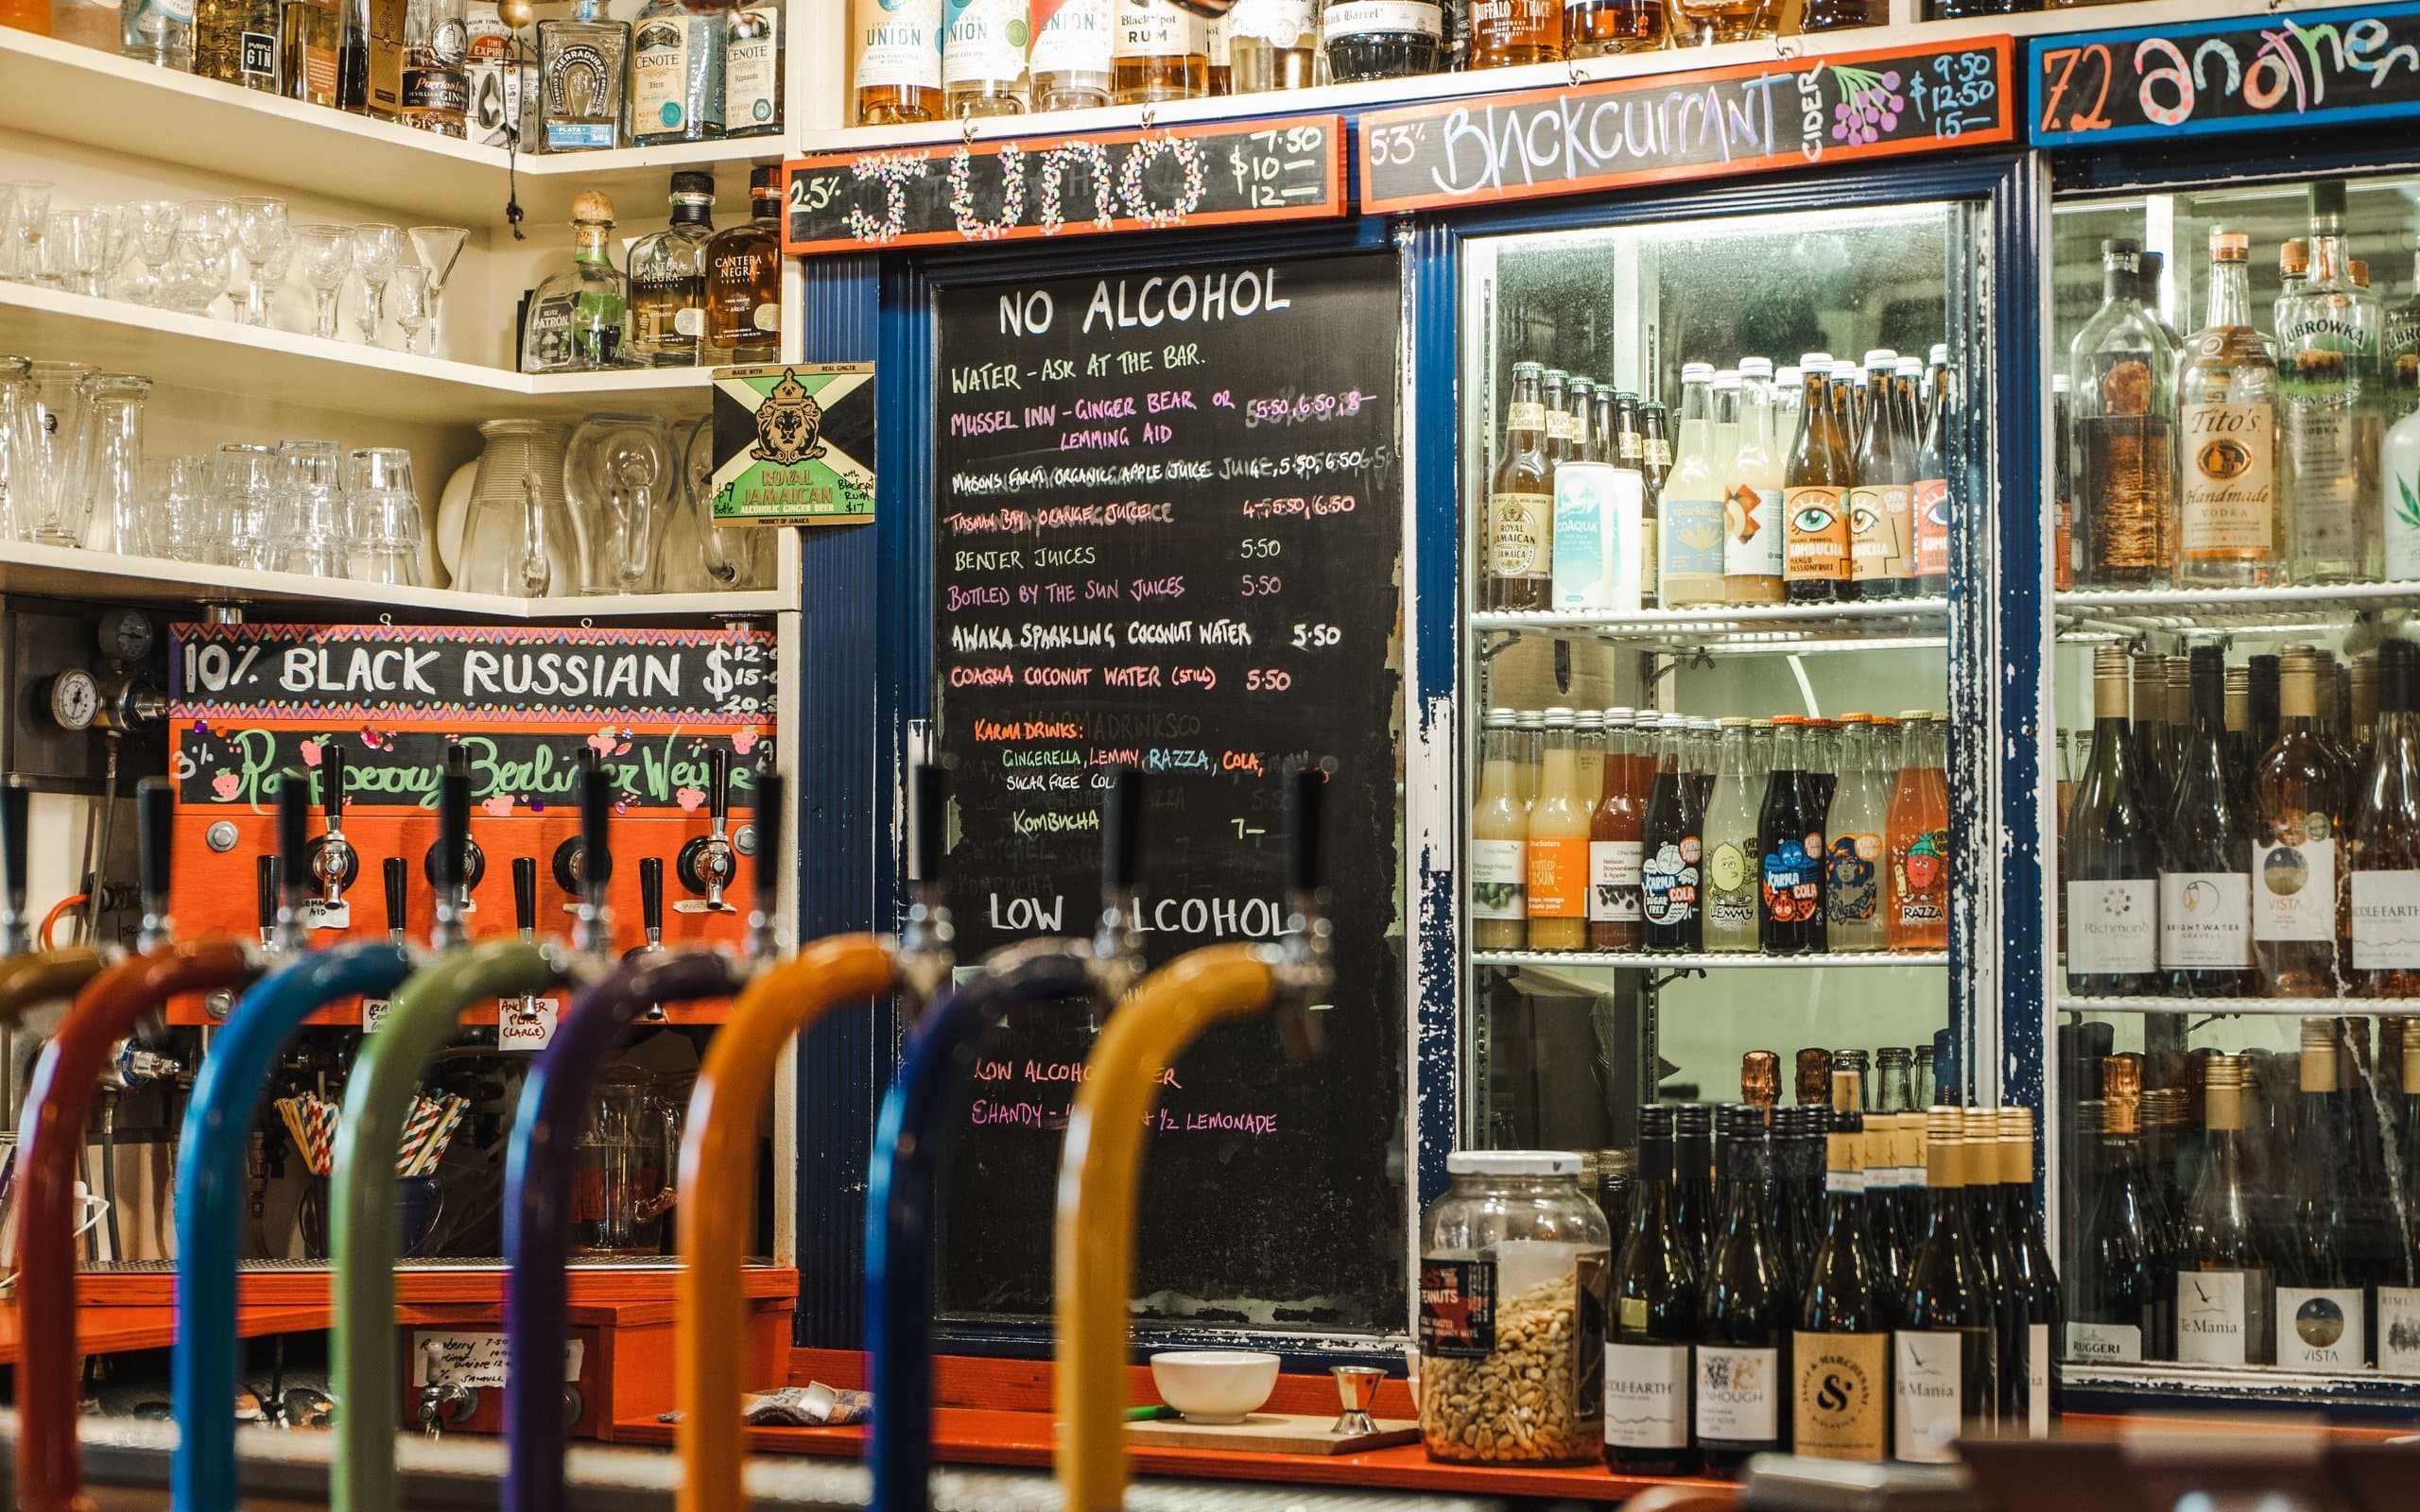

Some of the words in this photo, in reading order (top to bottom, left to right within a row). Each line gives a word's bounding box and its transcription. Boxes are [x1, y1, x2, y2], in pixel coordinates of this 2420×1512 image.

[1475, 1, 1512, 21] BUFFALO
[1120, 14, 1152, 26] Black
[486, 39, 504, 47] TIME
[866, 27, 922, 46] UNION
[1128, 29, 1168, 43] RUM
[247, 51, 271, 67] GIN
[634, 53, 681, 70] CENOTE
[727, 44, 769, 62] CENOTE
[554, 50, 606, 75] HERRADURA
[438, 91, 460, 103] GIN
[1797, 60, 1824, 163] CIDER
[636, 262, 682, 274] CANTERA
[715, 255, 763, 268] CANTERA
[643, 272, 679, 283] NEGRA
[720, 266, 757, 278] NEGRA
[998, 289, 1054, 337] NO
[1081, 267, 1291, 334] ALCOHOL
[952, 362, 1021, 394] WATER
[1042, 358, 1077, 382] ASK
[1087, 352, 1113, 378] AT
[1116, 350, 1153, 375] THE
[950, 410, 1019, 438] MUSSEL
[1024, 404, 1057, 429] INN
[1074, 396, 1137, 421] GINGER
[1147, 388, 1198, 415] BEAR
[1212, 388, 1236, 410] OR
[1060, 426, 1131, 452] LEMMING
[1142, 421, 1173, 446] AID
[762, 469, 814, 487] ROYAL
[952, 472, 1003, 495] MASONS
[1008, 465, 1045, 490] FARM
[1054, 464, 1113, 487] ORGANIC
[1121, 460, 1164, 481] APPLE
[1165, 459, 1214, 480] JUICE
[741, 486, 834, 506] JAMAICAN
[2185, 484, 2270, 506] Handmade
[739, 505, 780, 514] ALCOHOLIC
[783, 504, 811, 513] GINGER
[814, 503, 835, 512] BEER
[844, 503, 865, 514] $17
[2202, 508, 2249, 518] VODKA
[949, 511, 994, 532] TASMAN
[1038, 506, 1094, 527] ORANGE
[1499, 524, 1525, 533] ROYAL
[1494, 533, 1536, 545] JAMAICAN
[955, 549, 1024, 573] BENJER
[1035, 546, 1097, 568] JUICES
[1240, 539, 1282, 558] 5.50
[1498, 549, 1527, 558] JAMAICA
[1789, 542, 1844, 558] KOMBUCHA
[946, 584, 1011, 612] BOTTLED
[1018, 582, 1040, 606] BY
[1045, 582, 1076, 604] THE
[1084, 578, 1119, 600] SUN
[1130, 575, 1185, 602] JUICES
[1240, 574, 1282, 597] 5.50
[951, 622, 1015, 652] AWAKA
[1020, 621, 1116, 651] SPARKLING
[1127, 619, 1193, 645] COCONUT
[1199, 617, 1253, 646] WATER
[1291, 622, 1342, 652] 5.50
[184, 643, 262, 694] 10%
[279, 646, 441, 696] BLACK
[462, 649, 682, 698] RUSSIAN
[950, 664, 1014, 688] COAQUA
[1023, 666, 1093, 687] COCONUT
[1104, 663, 1162, 688] WATER
[1245, 668, 1292, 692] 5.50
[974, 717, 1022, 742] KARMA
[1006, 774, 1046, 792] SUGAR
[1047, 774, 1081, 791] FREE
[1645, 872, 1678, 894] KARMA
[1768, 870, 1801, 894] KARMA
[1668, 885, 1696, 902] COLA
[1793, 884, 1818, 901] COLA
[1647, 896, 1668, 907] SUGAR
[1649, 904, 1666, 915] FREE
[2268, 898, 2304, 912] VISTA
[308, 906, 327, 917] AID
[990, 892, 1064, 932] LOW
[1108, 896, 1302, 938] LCOHOL
[1710, 905, 1754, 920] LEMMY
[1903, 906, 1945, 919] RAZZA
[2083, 920, 2151, 936] Richmond
[973, 1057, 1011, 1080] LOW
[1185, 1111, 1277, 1135] LEMONADE
[2179, 1317, 2191, 1332] Te
[2193, 1317, 2238, 1334] Mania
[2072, 1341, 2121, 1354] RUGGERI
[2302, 1349, 2340, 1363] VISTA
[1910, 1381, 1955, 1399] Mania
